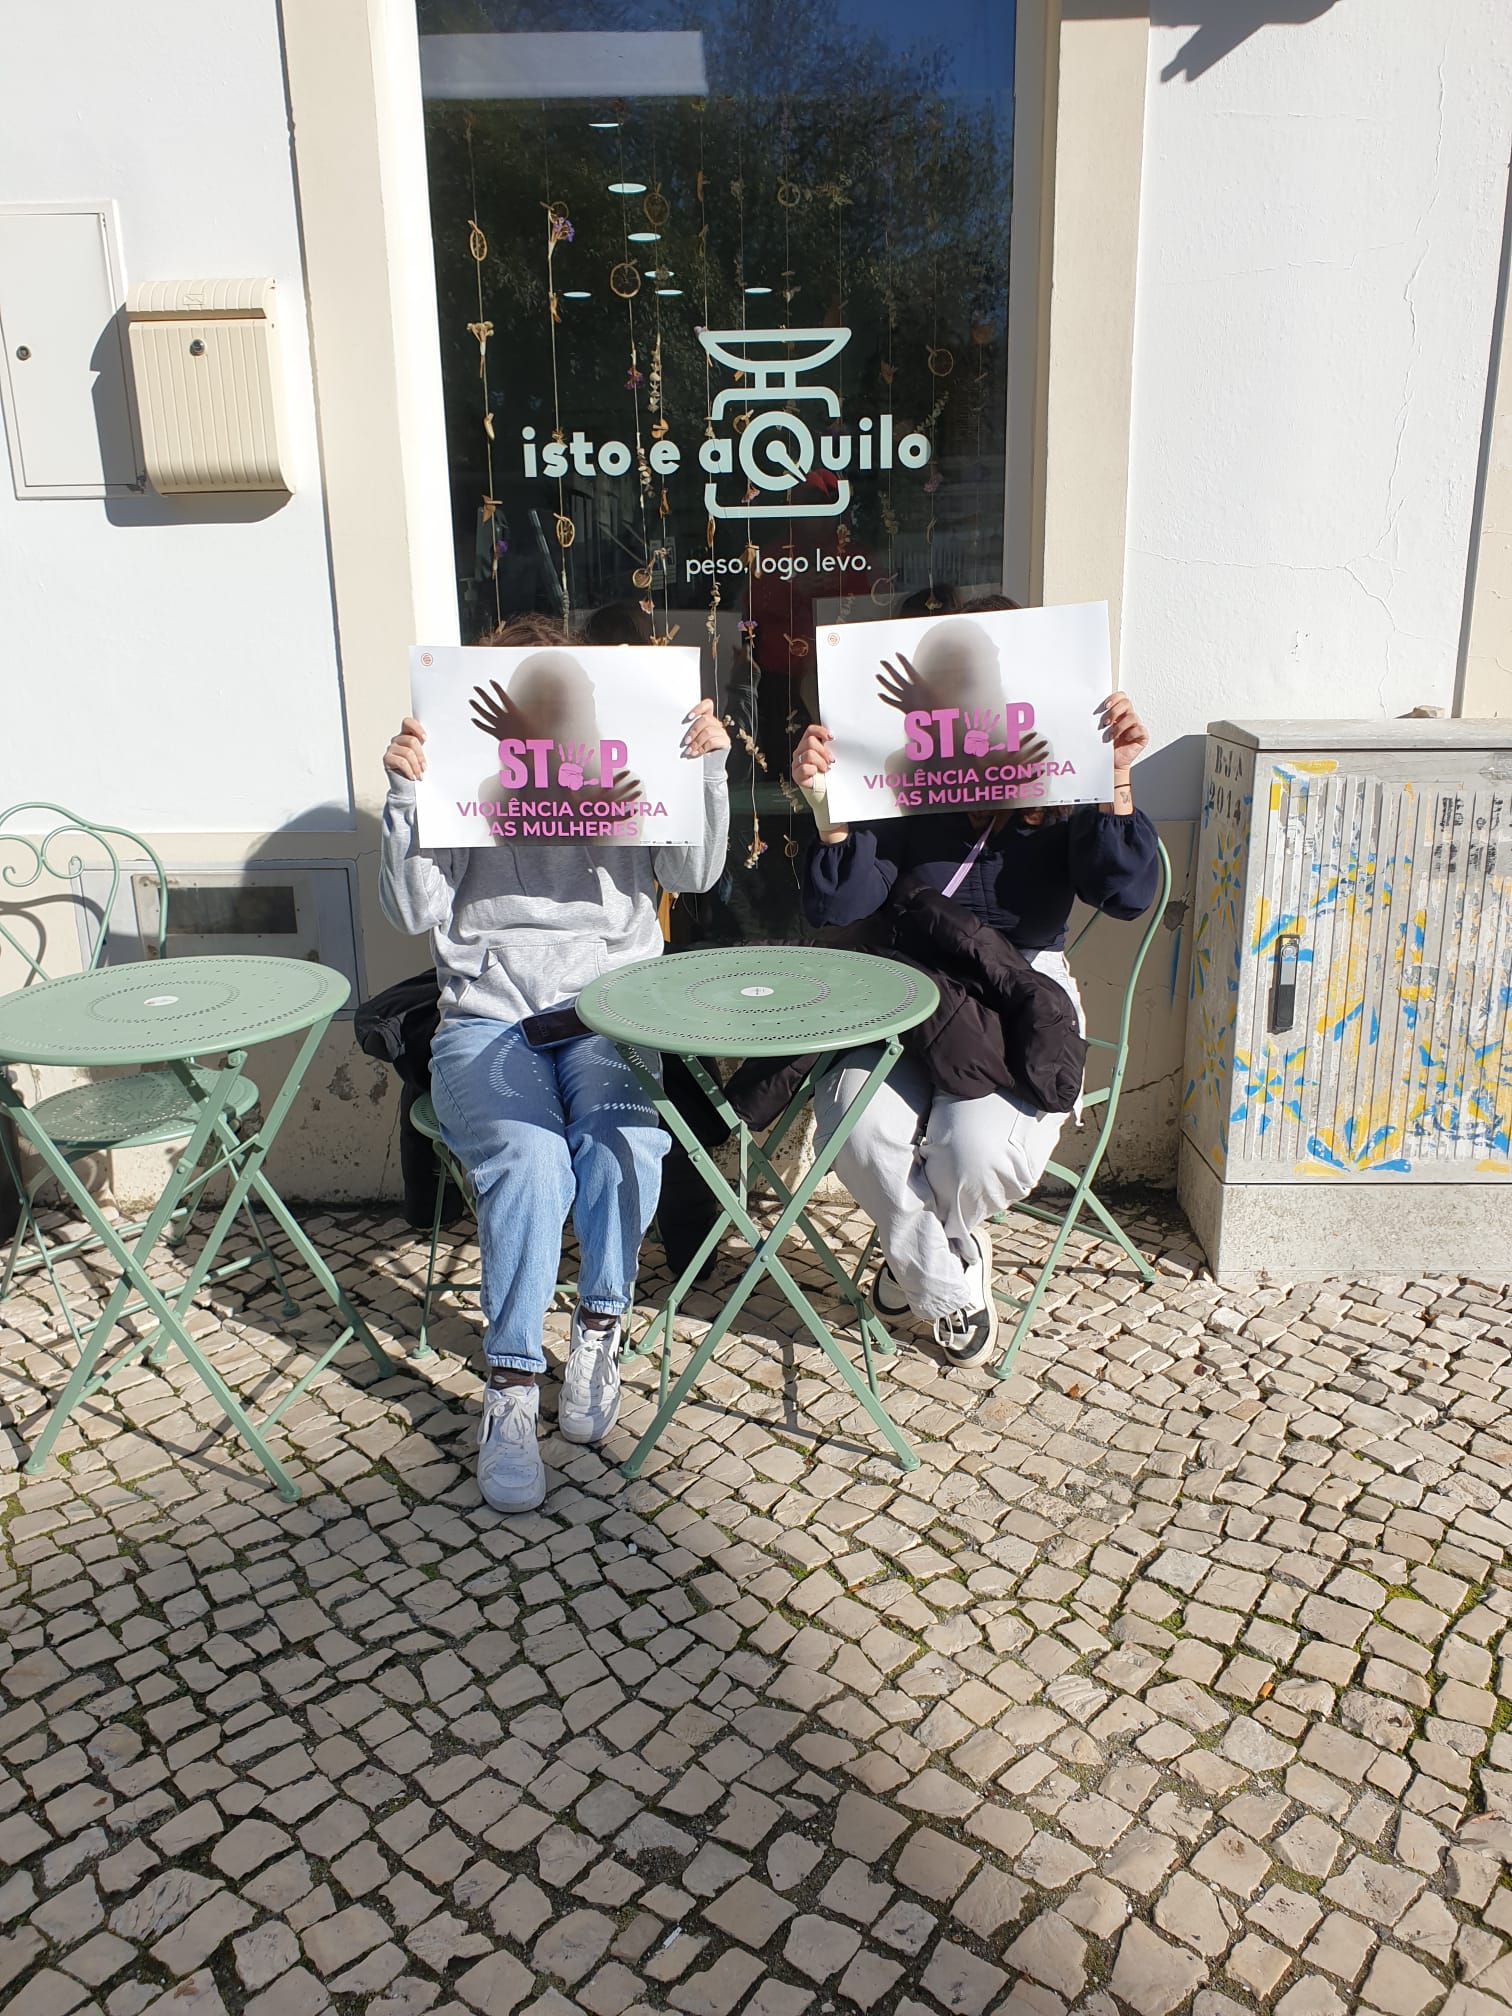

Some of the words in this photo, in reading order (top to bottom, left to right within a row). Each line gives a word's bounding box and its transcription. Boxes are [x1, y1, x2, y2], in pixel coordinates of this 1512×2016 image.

[521, 425, 632, 478] isto
[650, 440, 681, 475] e
[755, 549, 809, 581] logo
[816, 548, 872, 572] levo.
[863, 767, 979, 790] VIOLÊNCIA
[984, 760, 1076, 782] CONTRA
[456, 797, 574, 818] VIOLÊNCIA
[579, 801, 668, 817] CONTRA
[894, 790, 922, 807] AS
[928, 782, 1045, 805] MULHERES
[488, 821, 517, 837] AS
[523, 821, 639, 837] MULHERES
